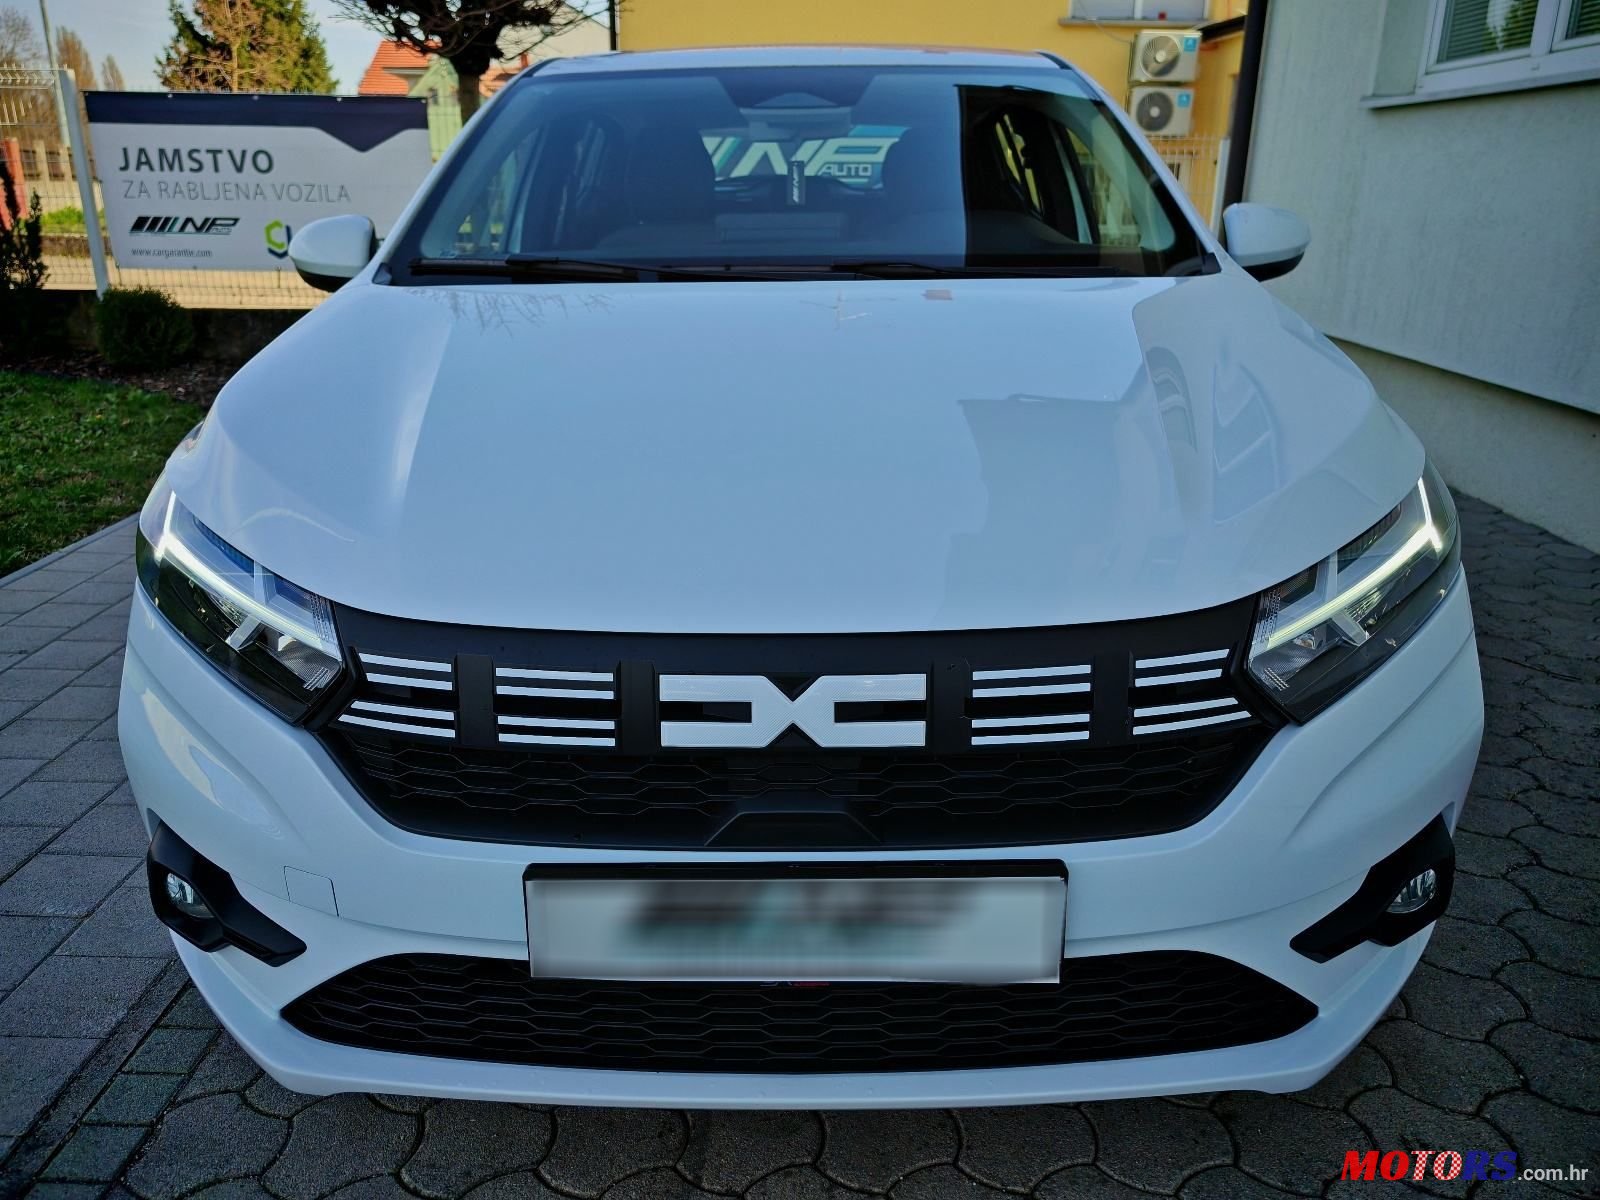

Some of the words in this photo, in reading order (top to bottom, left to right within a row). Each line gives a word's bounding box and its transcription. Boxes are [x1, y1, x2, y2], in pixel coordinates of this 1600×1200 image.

[119, 147, 274, 174] JAMSTVO
[817, 164, 872, 176] AUTO
[122, 180, 151, 199] ZA
[158, 181, 267, 201] RABLJENA
[272, 183, 351, 203] VOZILA
